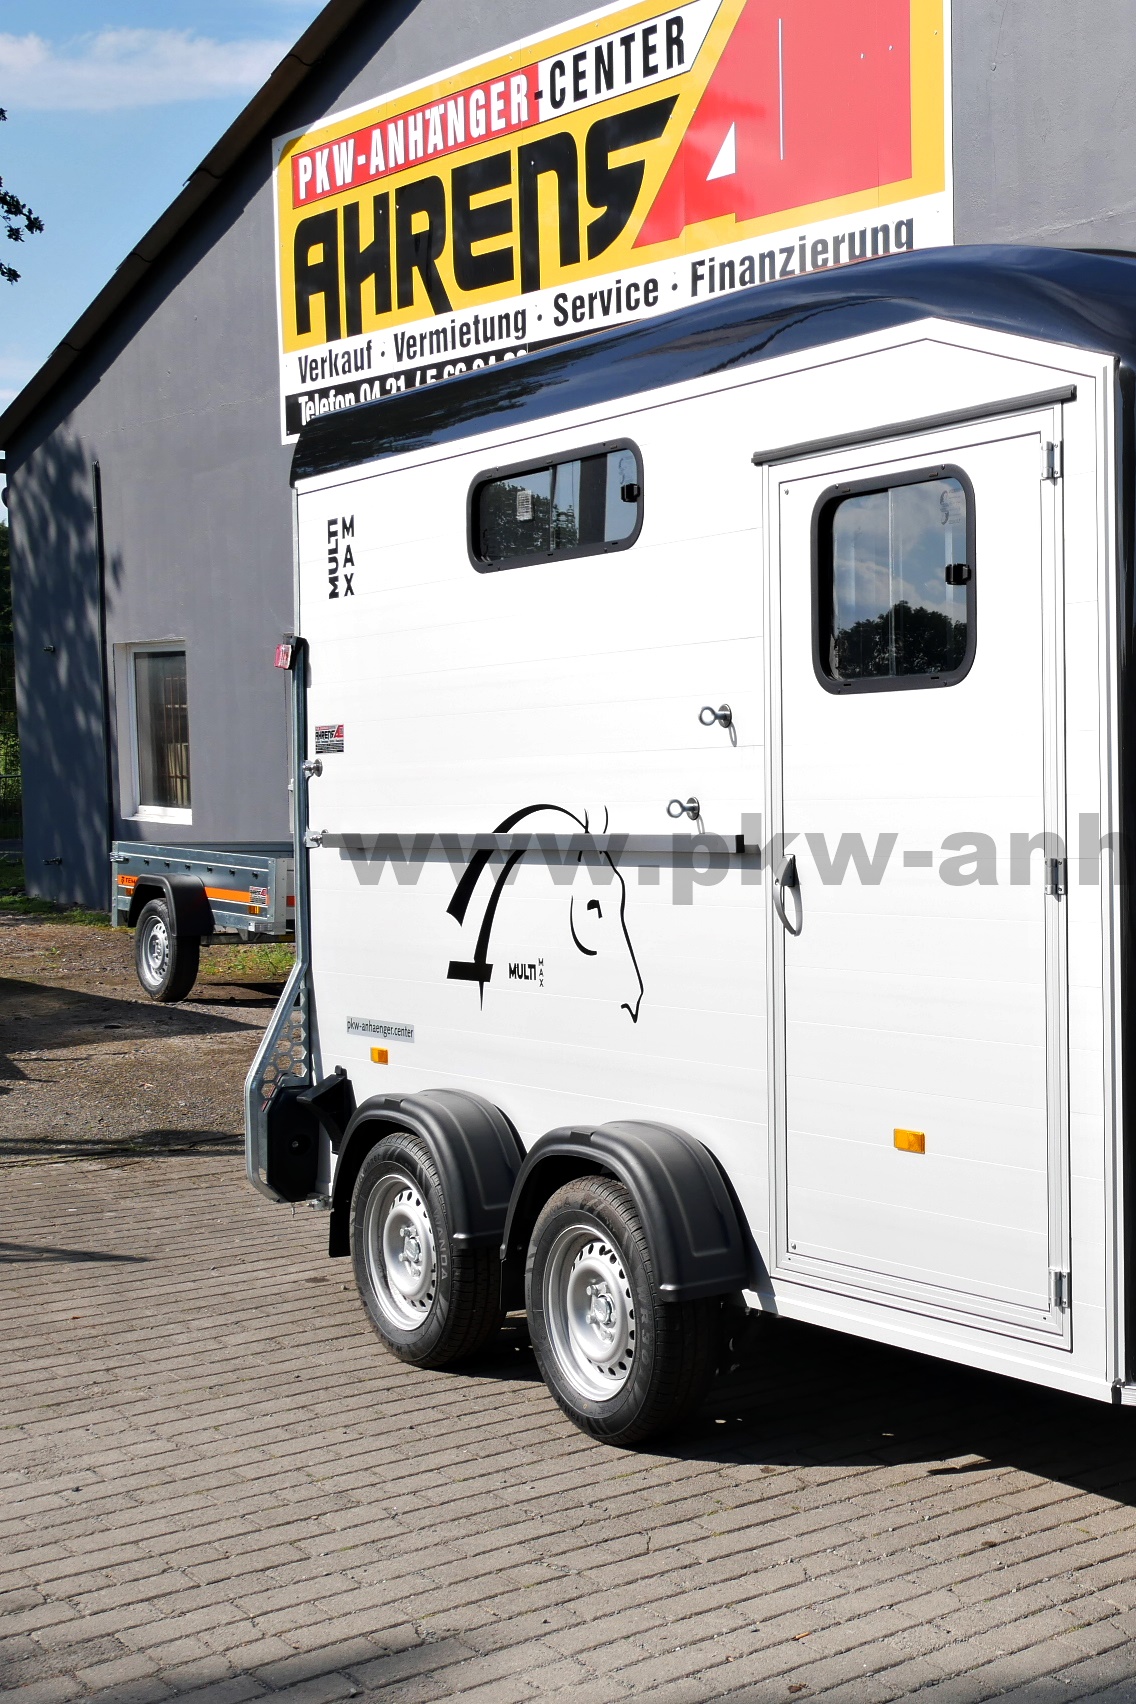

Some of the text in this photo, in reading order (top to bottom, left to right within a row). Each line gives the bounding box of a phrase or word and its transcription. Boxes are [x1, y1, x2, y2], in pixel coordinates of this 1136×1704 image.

[293, 94, 681, 344] AHRENS
[298, 340, 373, 384] Verkauf
[394, 306, 527, 363] Vermietung
[553, 278, 659, 327] Service
[690, 217, 914, 298] Finanzierung
[341, 514, 355, 597] MAX
[509, 963, 537, 980] MULTI
[346, 1017, 414, 1038] pkw-anhaenger.center
[433, 1209, 448, 1279] WANDA
